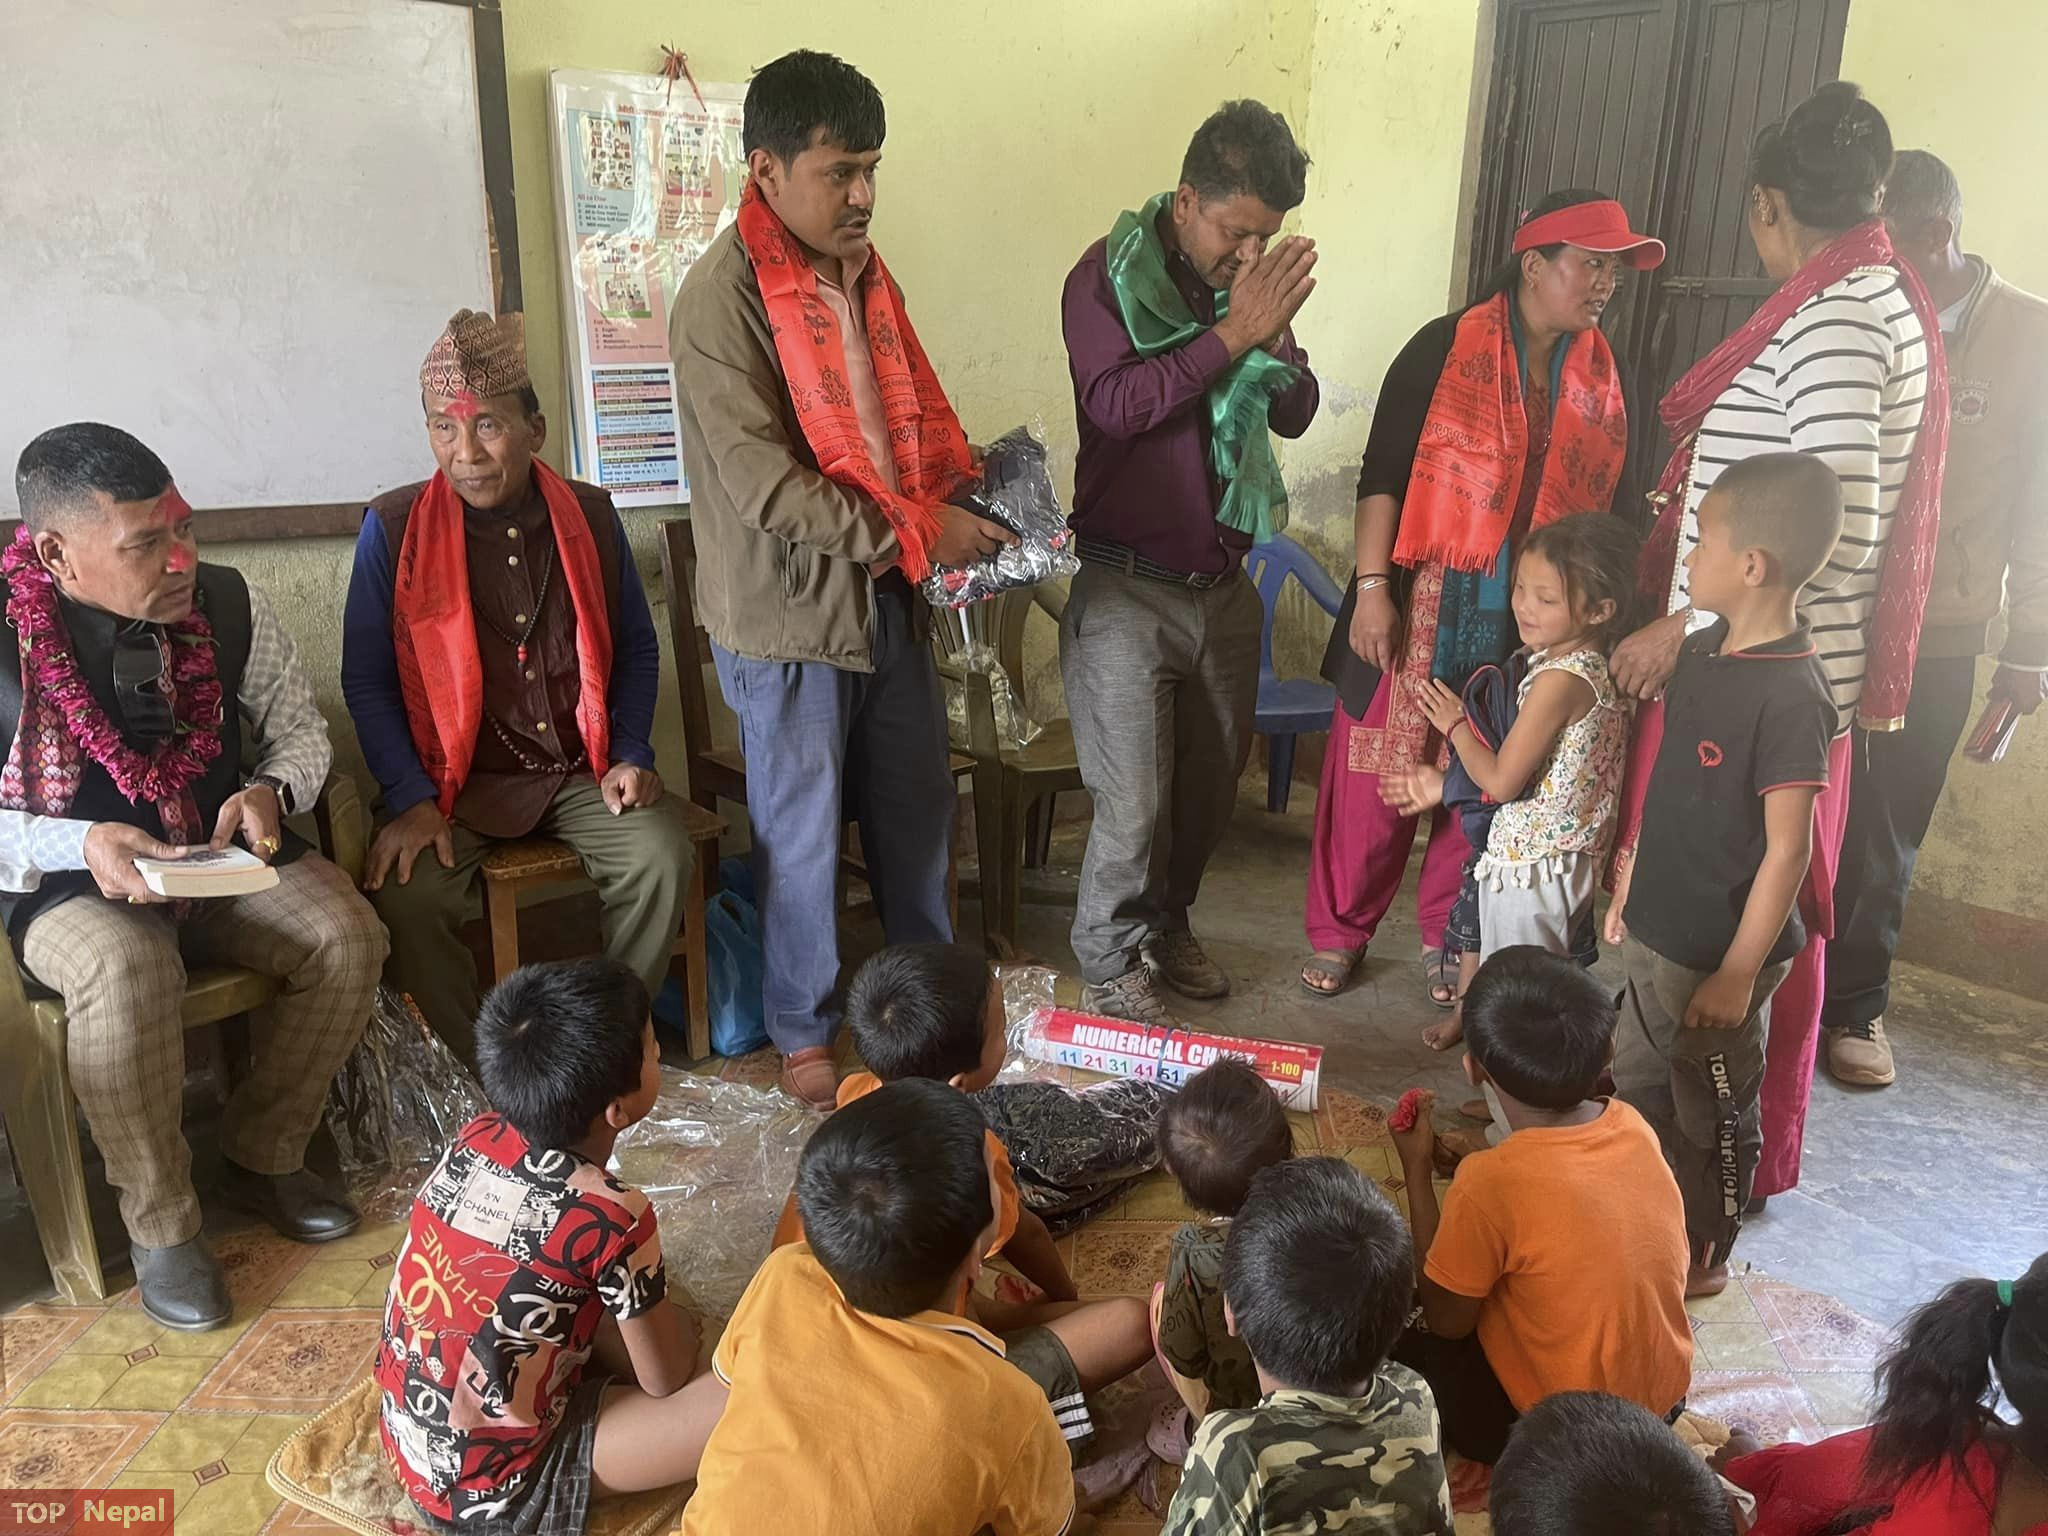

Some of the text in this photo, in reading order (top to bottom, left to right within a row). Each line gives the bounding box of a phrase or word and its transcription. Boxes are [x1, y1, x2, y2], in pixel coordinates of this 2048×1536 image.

[1072, 1023, 1184, 1063] NUMERICAL
[1059, 1048, 1078, 1065] 11
[1083, 1053, 1103, 1069] 21
[1109, 1058, 1129, 1074] 31
[1134, 1062, 1154, 1078] 41
[1160, 1067, 1180, 1083] 51
[1271, 1060, 1301, 1077] 1-100
[463, 1199, 511, 1222] CHANEL
